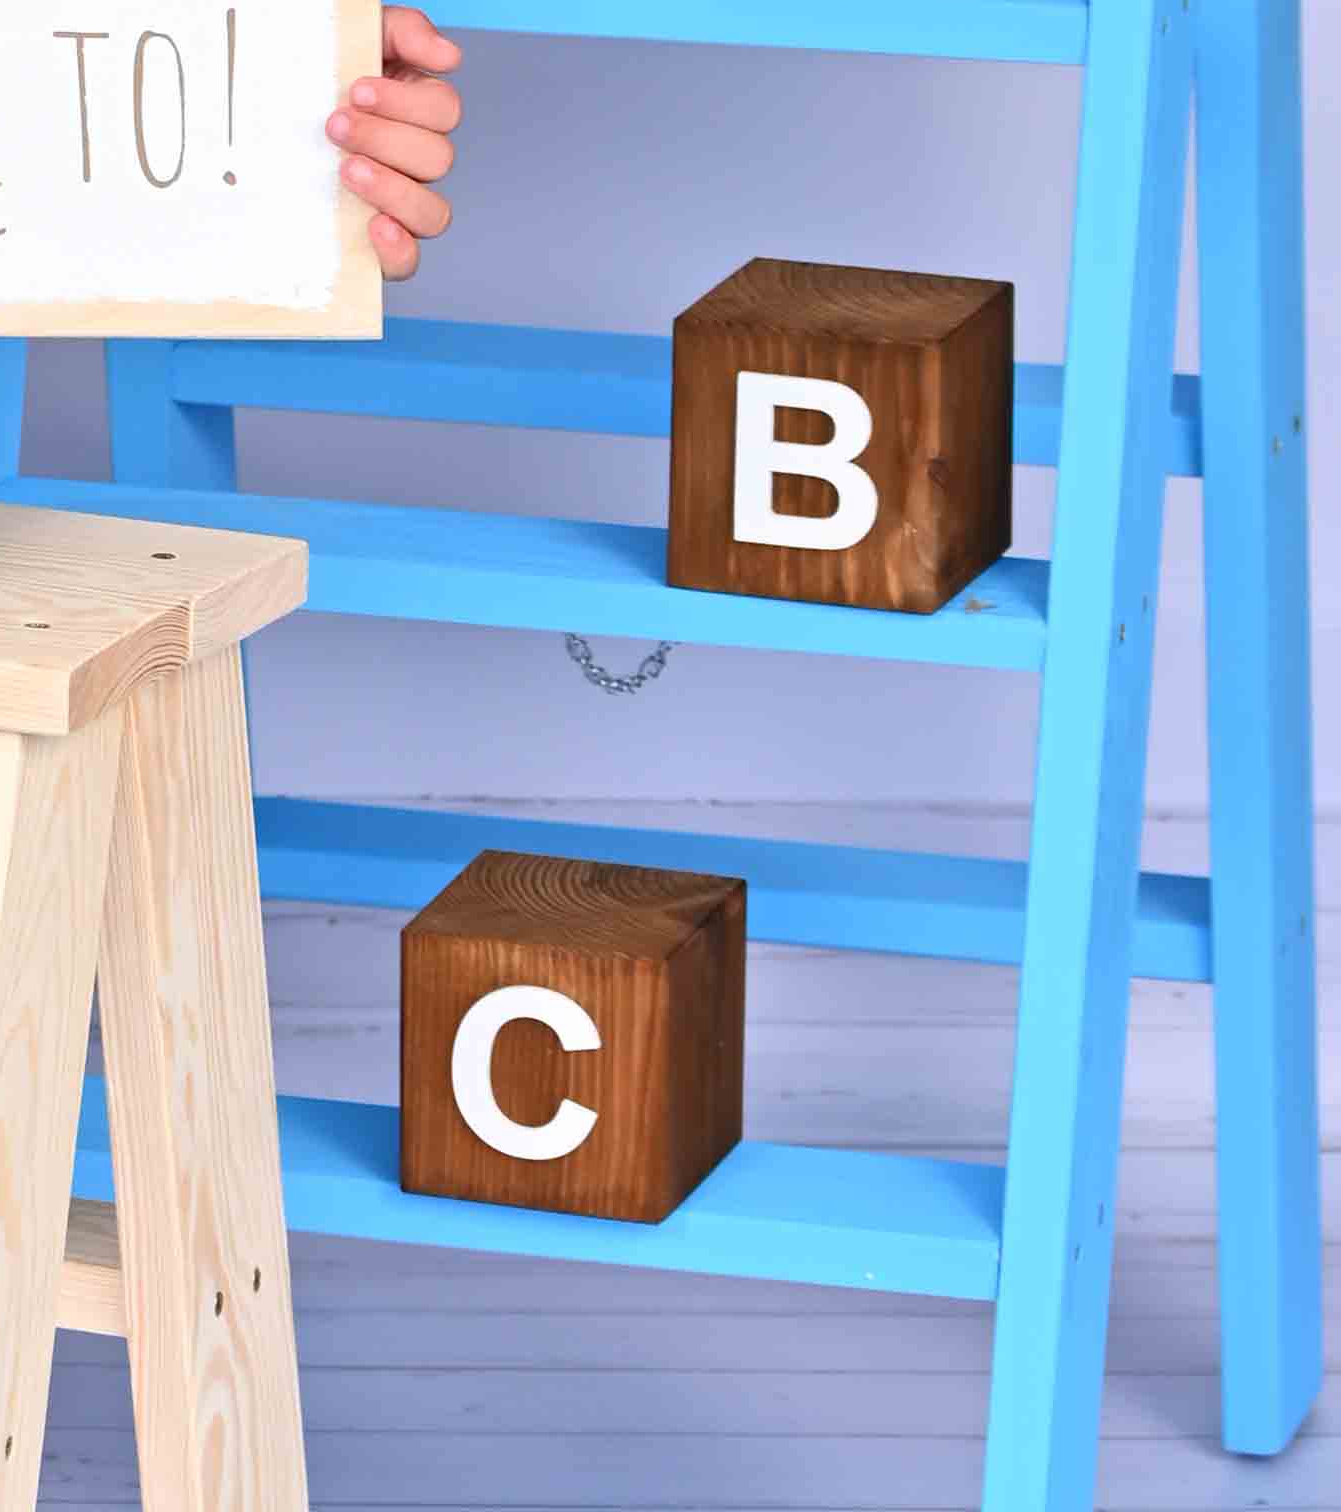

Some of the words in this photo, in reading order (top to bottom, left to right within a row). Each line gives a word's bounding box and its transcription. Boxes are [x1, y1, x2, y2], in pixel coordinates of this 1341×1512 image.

[53, 8, 237, 189] TO!
[734, 371, 878, 550] B
[451, 985, 602, 1161] C
